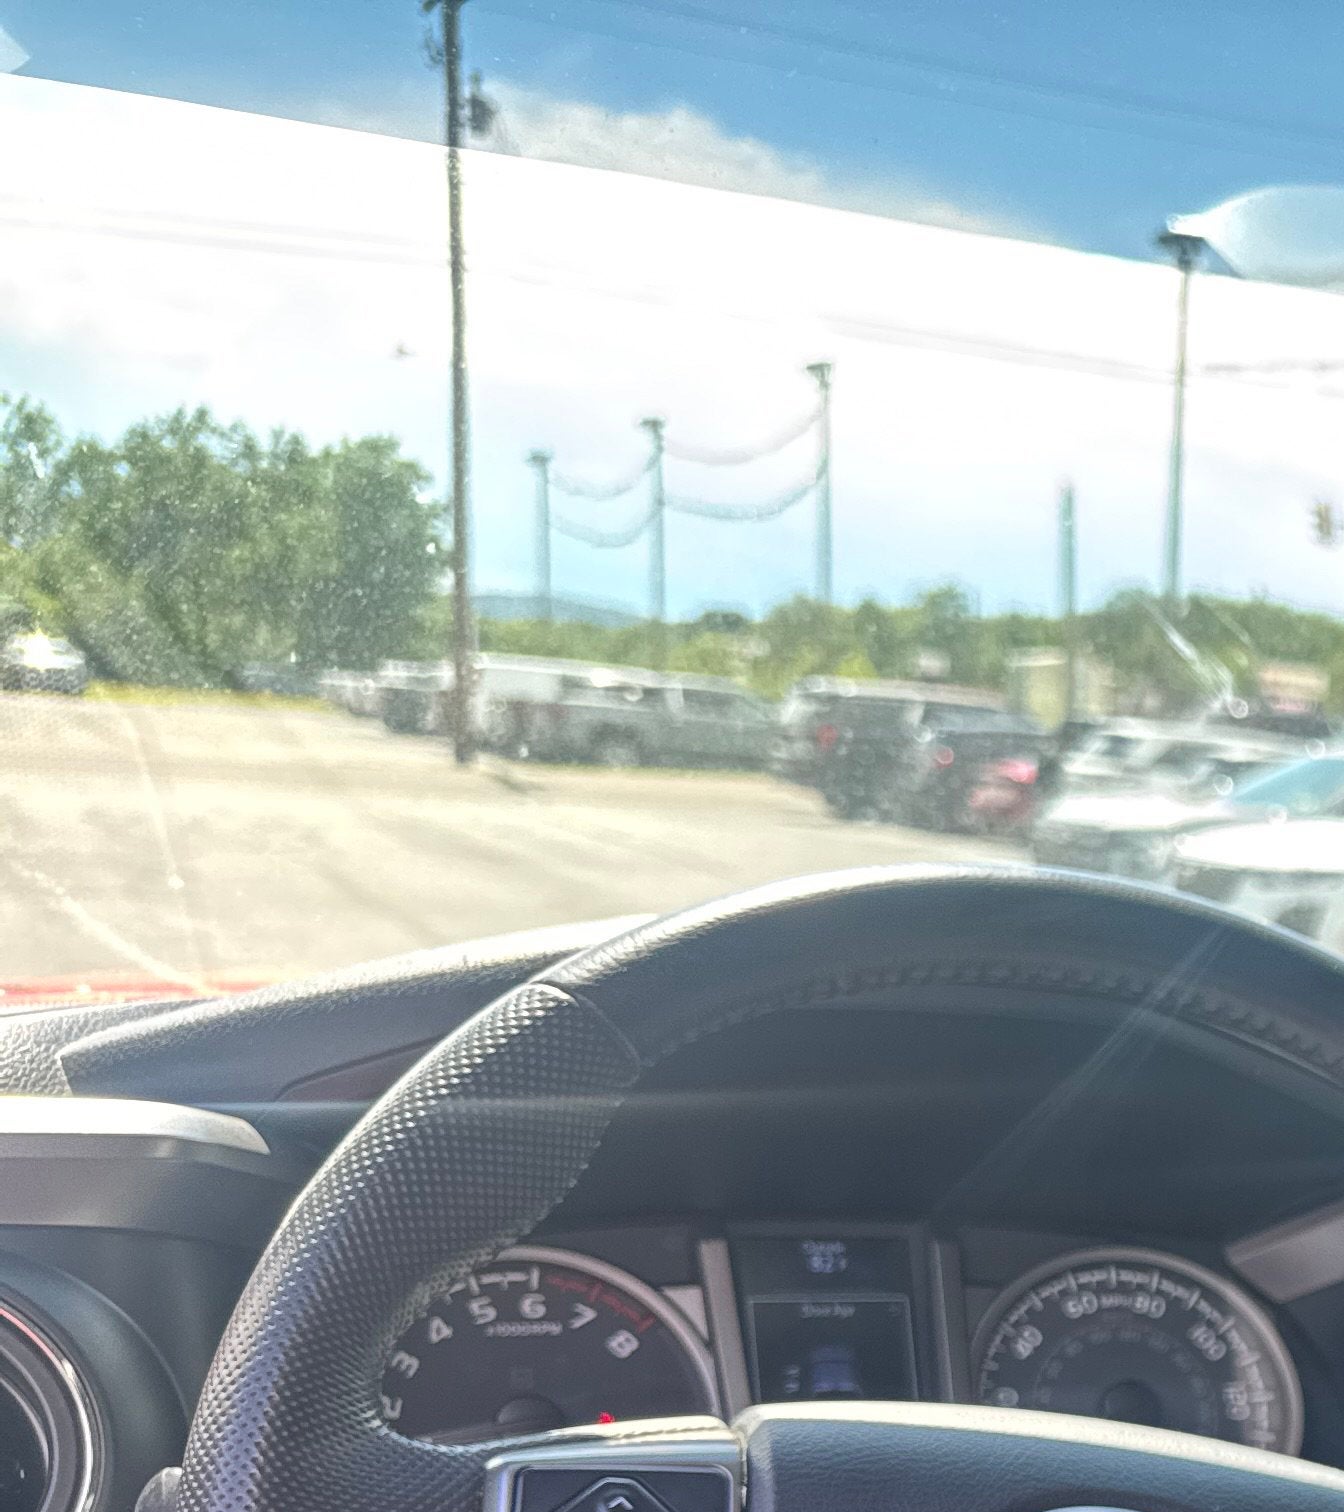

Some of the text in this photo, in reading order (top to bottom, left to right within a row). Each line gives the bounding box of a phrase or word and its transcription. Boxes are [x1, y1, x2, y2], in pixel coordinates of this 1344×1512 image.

[466, 1293, 498, 1325] 5
[520, 1290, 547, 1319] 6
[568, 1302, 599, 1330] 7
[428, 1315, 455, 1345] 4
[605, 1327, 640, 1360] 8
[391, 1351, 420, 1379] 3
